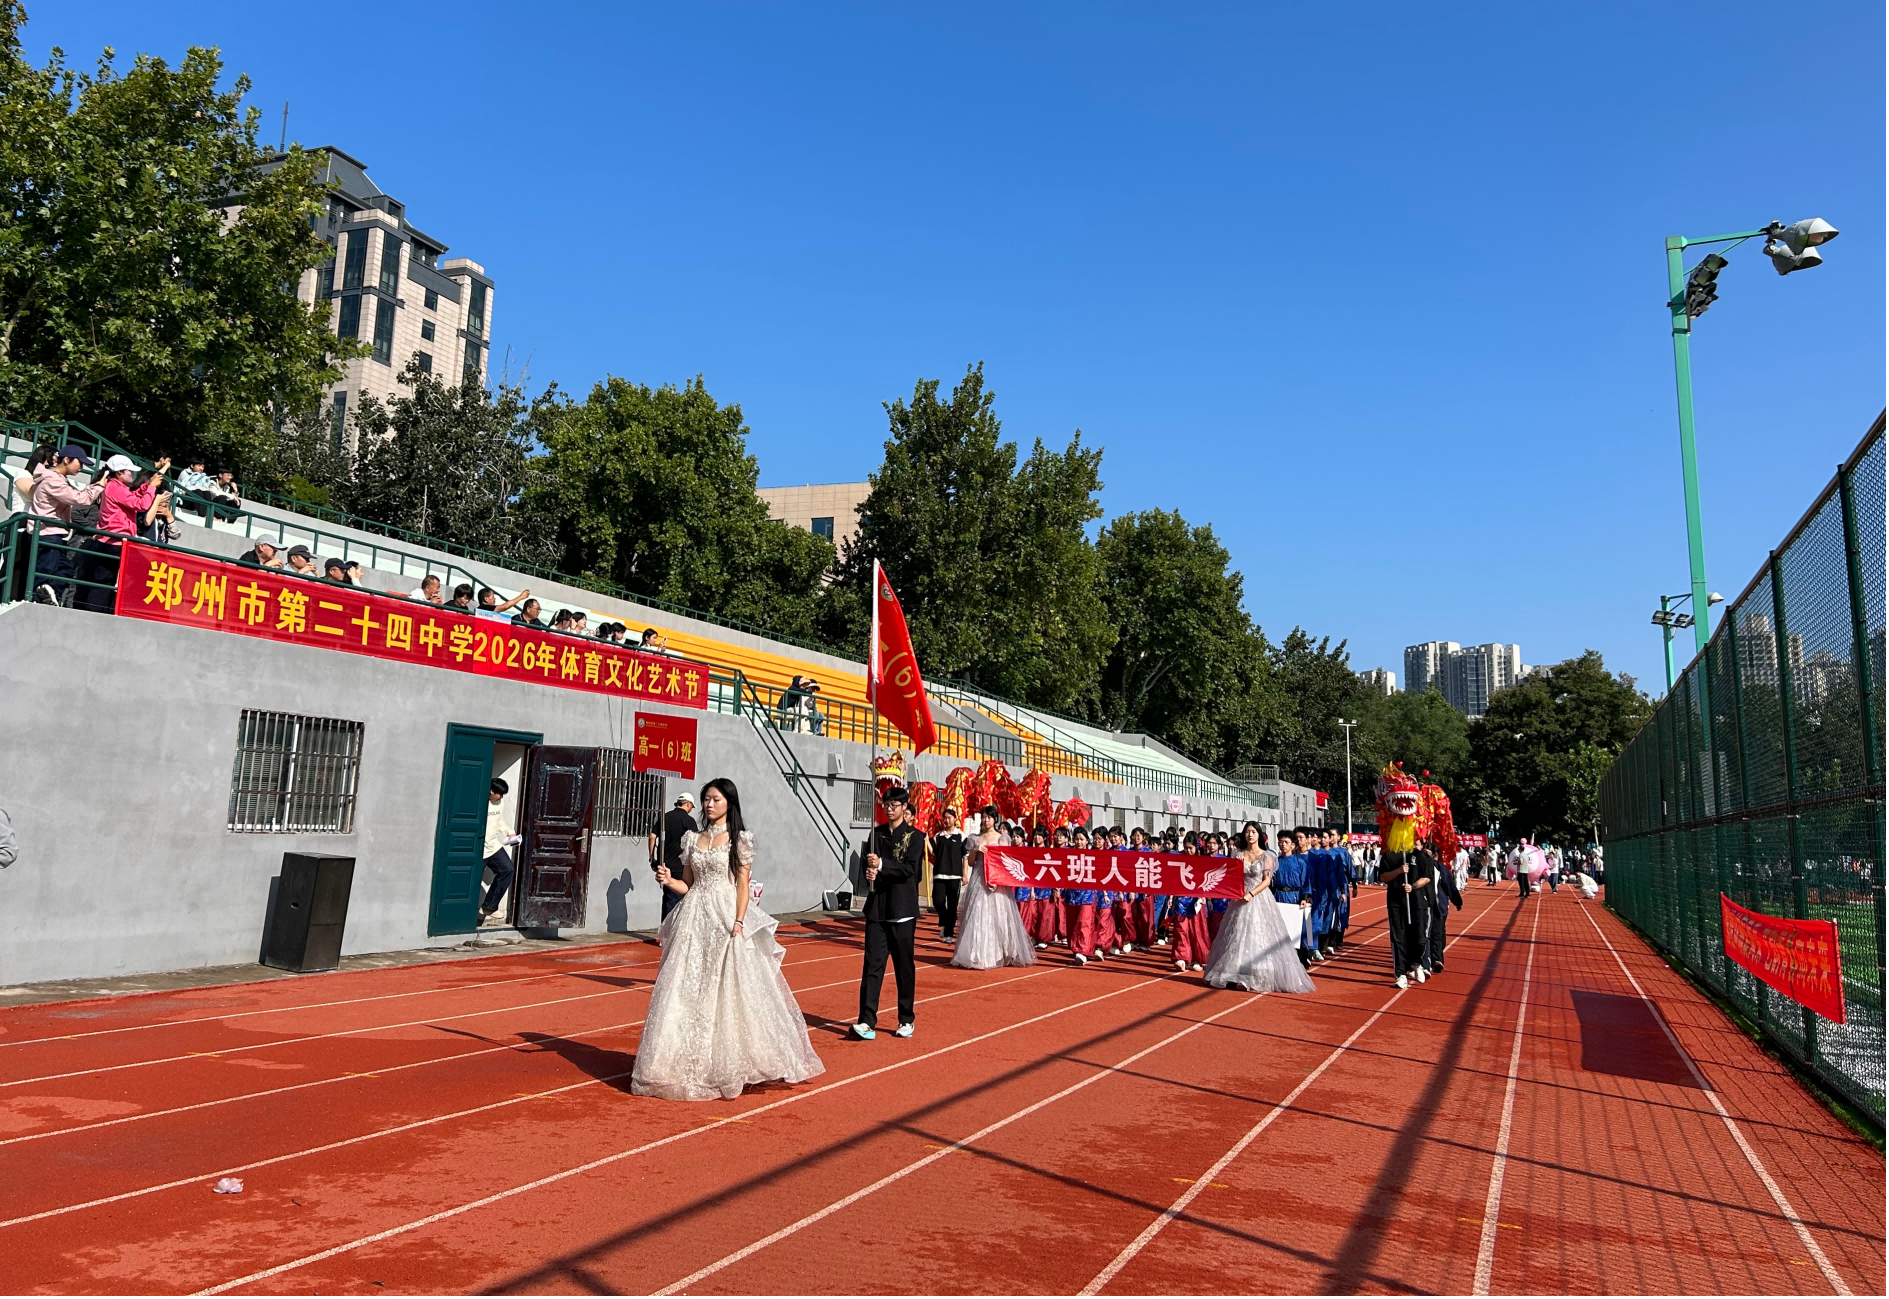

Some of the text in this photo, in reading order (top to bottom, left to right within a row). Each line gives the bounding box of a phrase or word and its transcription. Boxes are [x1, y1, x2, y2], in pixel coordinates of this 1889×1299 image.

[143, 560, 700, 700] 郑州市第二十四中学2026年体育文化艺术节
[1033, 852, 1197, 890] 六班人能飞
